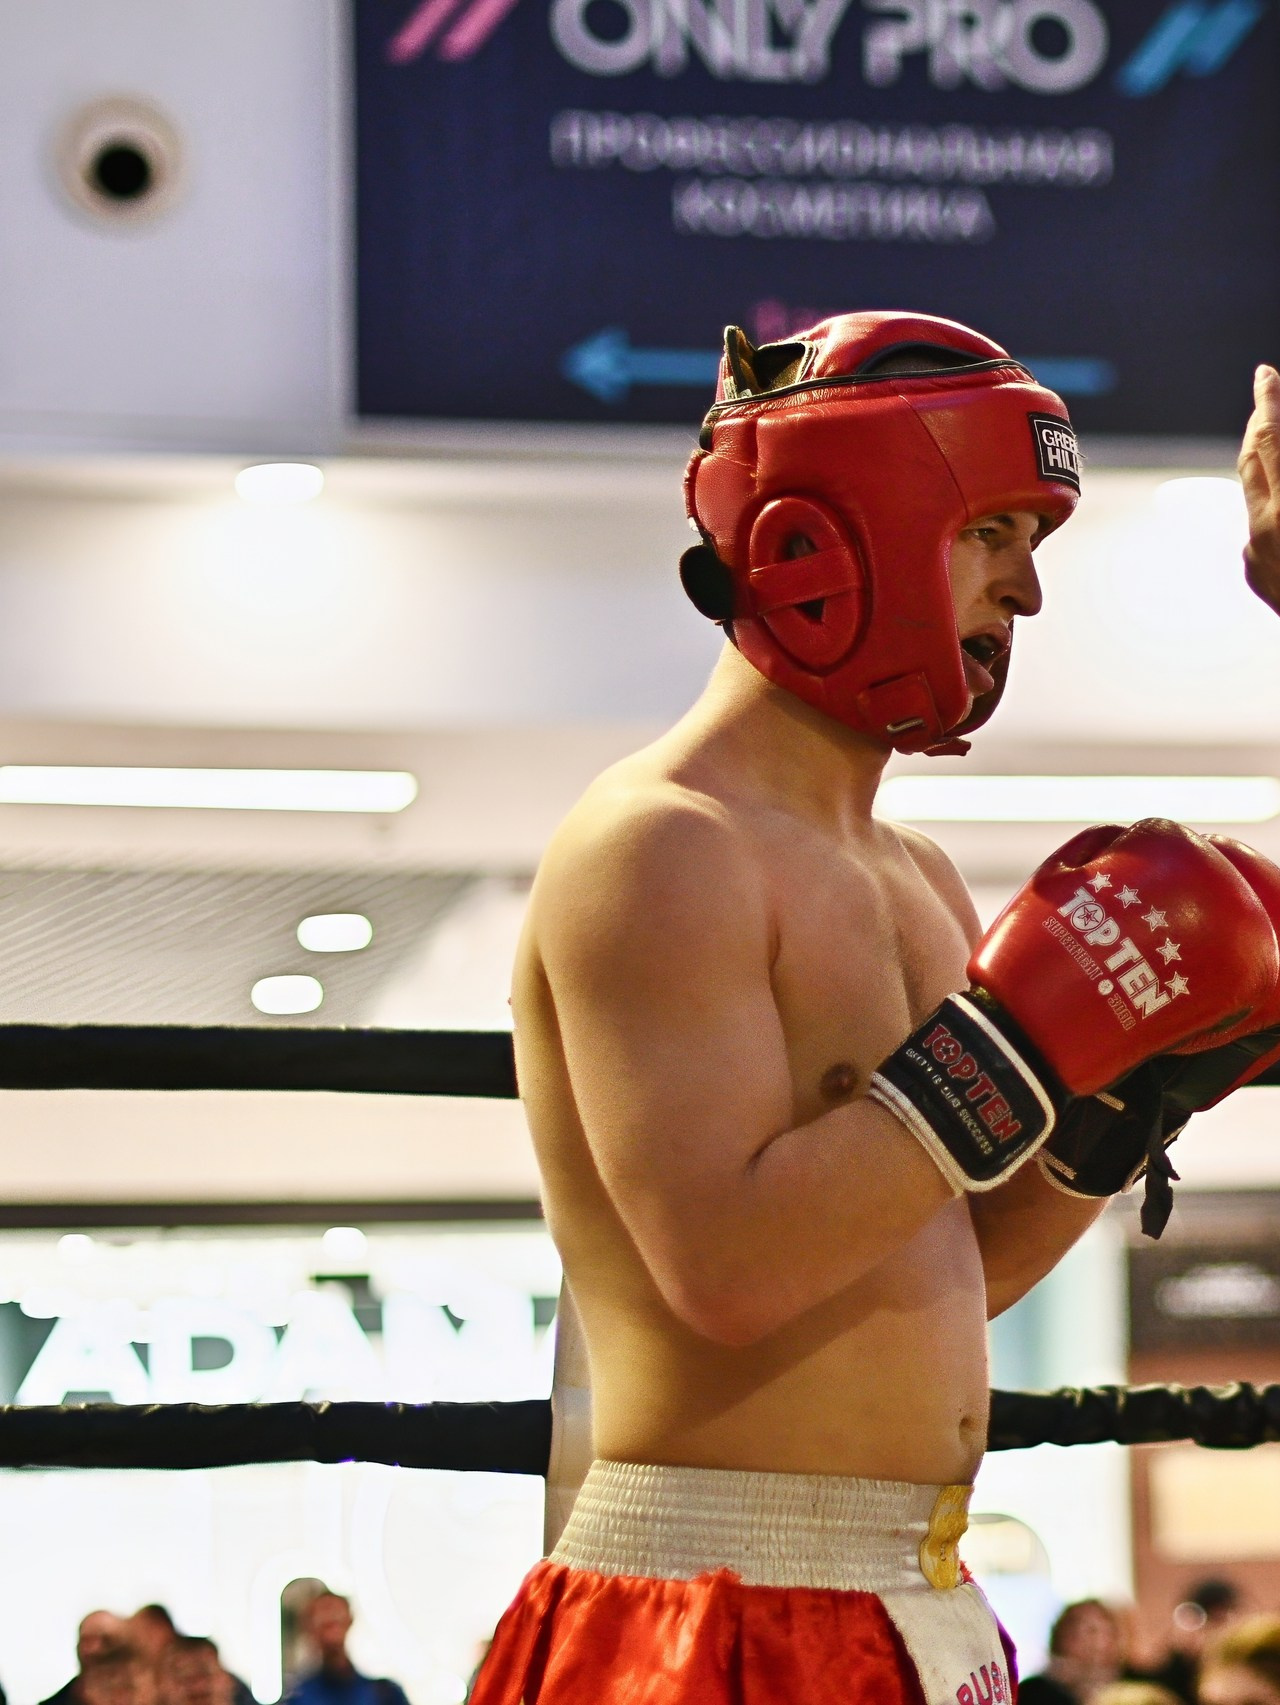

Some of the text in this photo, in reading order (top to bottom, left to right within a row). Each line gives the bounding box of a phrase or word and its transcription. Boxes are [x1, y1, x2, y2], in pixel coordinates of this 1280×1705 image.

[549, 0, 1110, 94] ONLY PRO
[1057, 885, 1172, 1020] TOP TEN
[922, 1023, 1023, 1144] TOP TEN
[16, 1286, 556, 1404] ADAM
